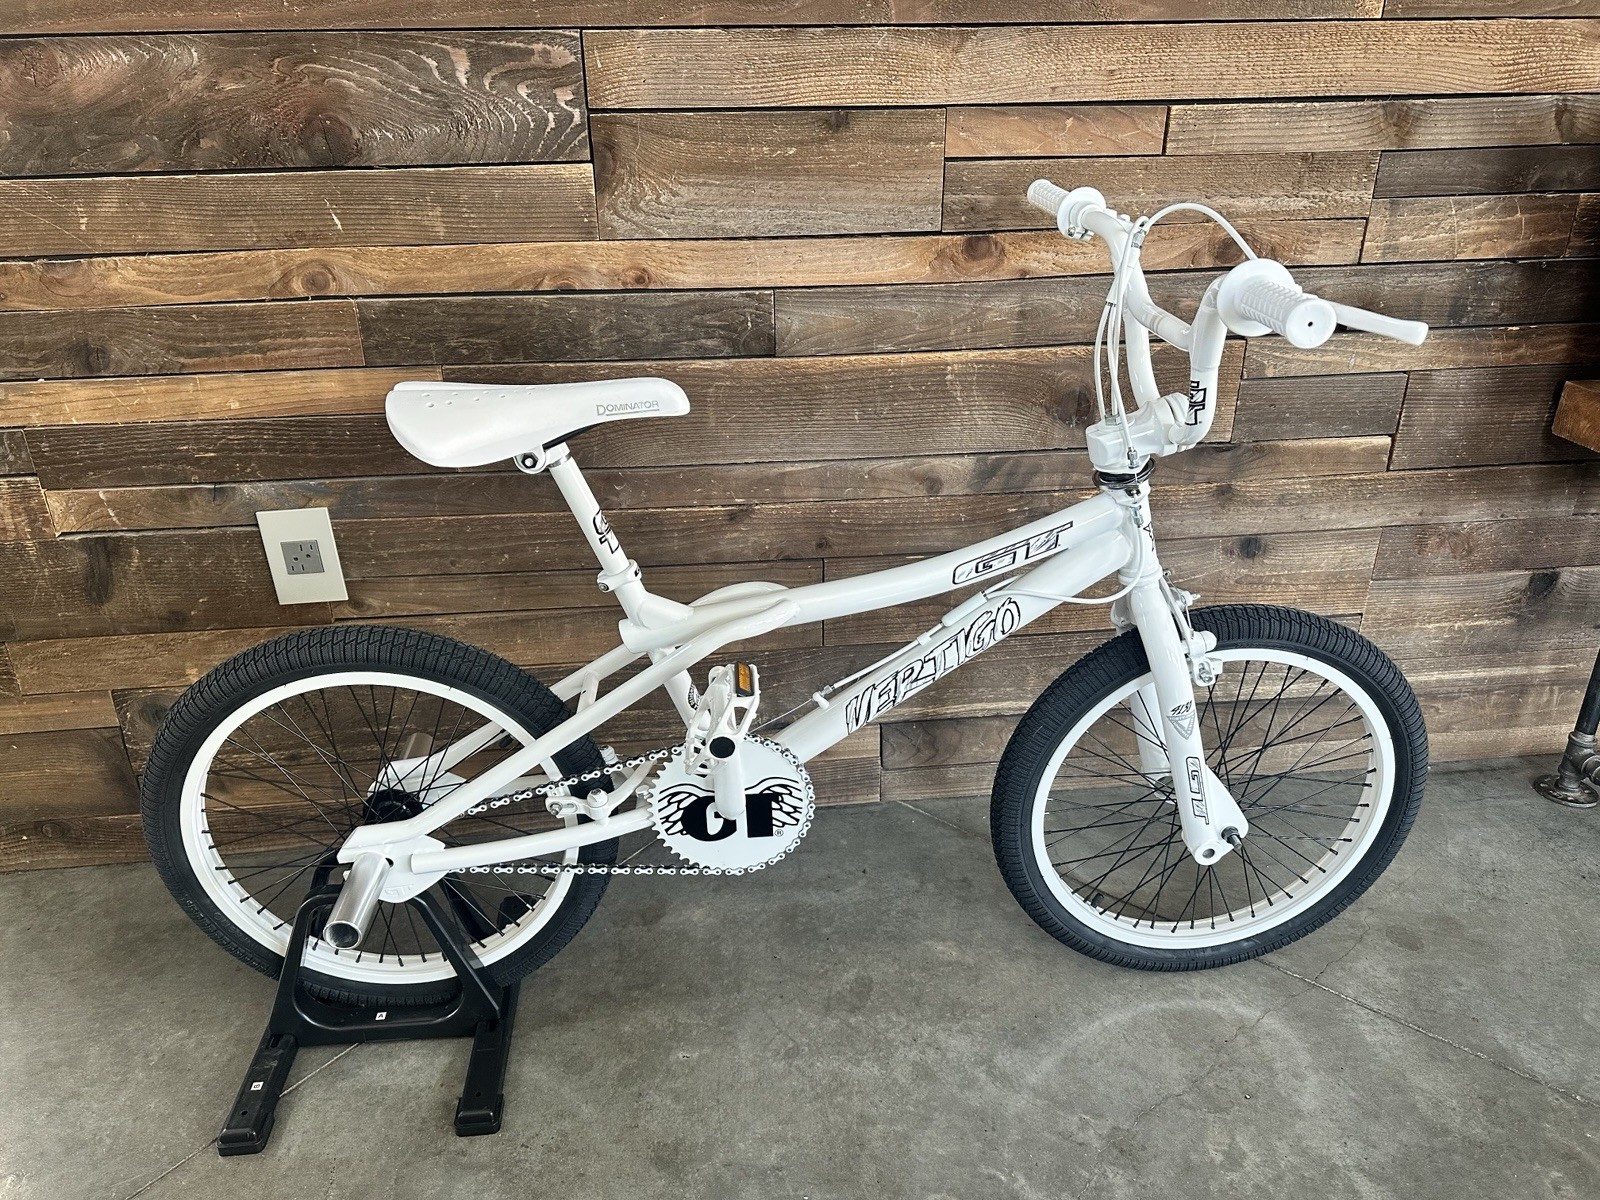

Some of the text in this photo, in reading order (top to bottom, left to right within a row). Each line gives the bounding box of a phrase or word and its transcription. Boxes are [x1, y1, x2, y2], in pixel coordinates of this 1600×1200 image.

[596, 400, 660, 416] DOMINATOR
[952, 520, 1074, 585] GT
[845, 597, 1021, 736] VERTIGO
[1185, 756, 1210, 825] GT
